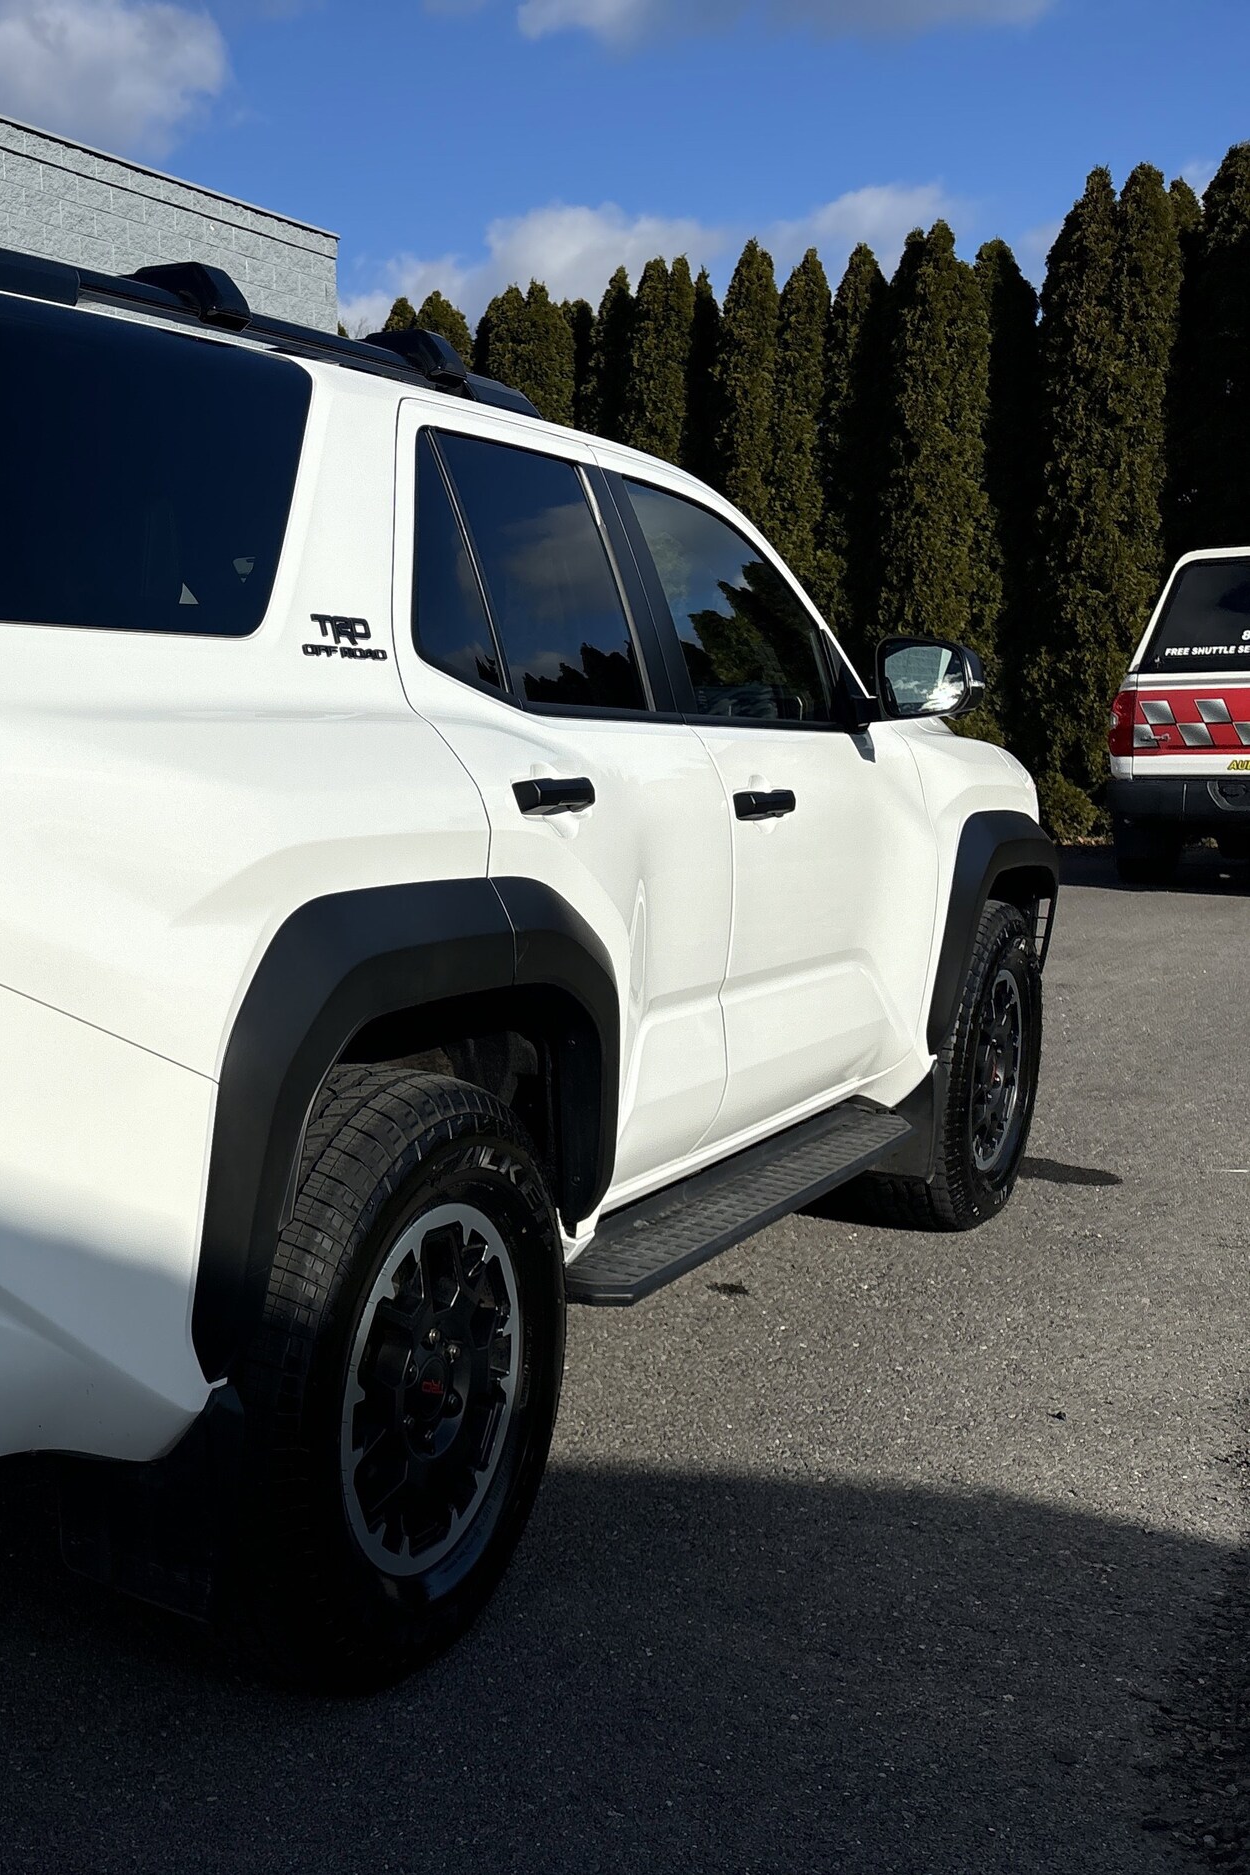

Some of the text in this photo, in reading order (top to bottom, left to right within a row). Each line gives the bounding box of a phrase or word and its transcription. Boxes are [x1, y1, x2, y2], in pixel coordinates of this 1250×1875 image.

[310, 613, 371, 645] TRD
[302, 644, 387, 661] OFF ROAD
[1165, 647, 1190, 657] FREE
[1191, 645, 1236, 655] SHUTTLE
